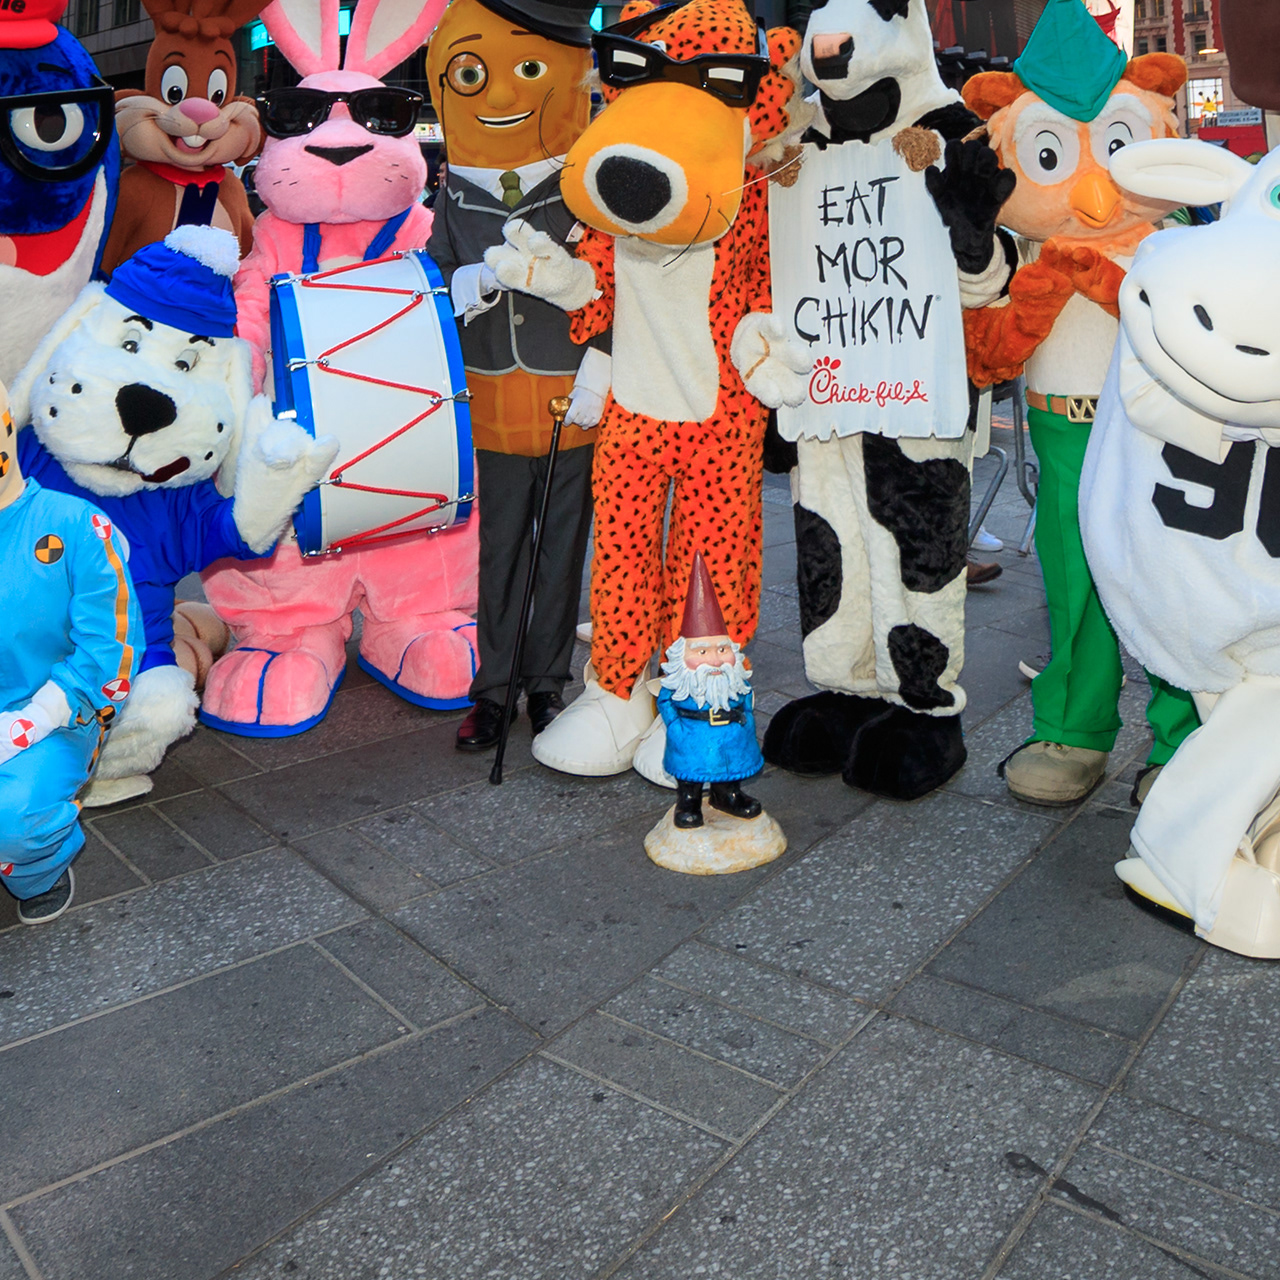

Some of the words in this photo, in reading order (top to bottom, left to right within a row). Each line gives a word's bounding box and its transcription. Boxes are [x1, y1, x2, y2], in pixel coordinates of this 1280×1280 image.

[818, 177, 900, 226] EAT
[815, 236, 908, 292] MOR
[794, 295, 933, 347] CHIKIN
